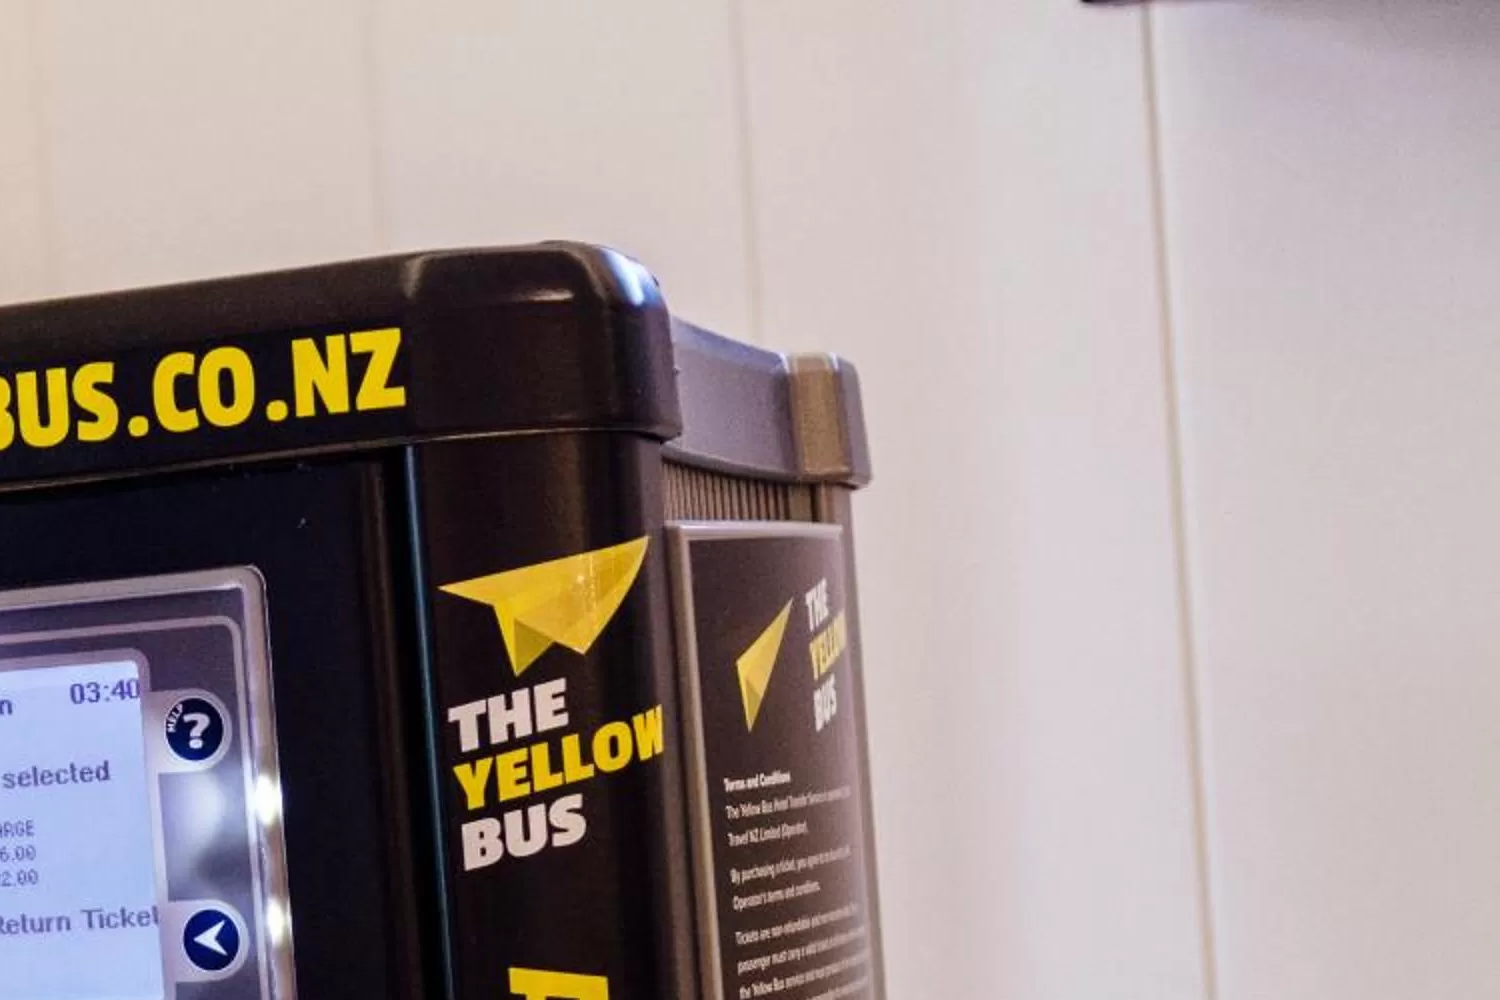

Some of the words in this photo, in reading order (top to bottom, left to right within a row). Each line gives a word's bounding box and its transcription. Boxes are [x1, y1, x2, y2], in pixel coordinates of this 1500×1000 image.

[70, 679, 140, 704] 03:40
[448, 678, 569, 752] THE
[3, 761, 110, 789] selected
[453, 704, 664, 810] YELLOW
[461, 794, 587, 871] BUS
